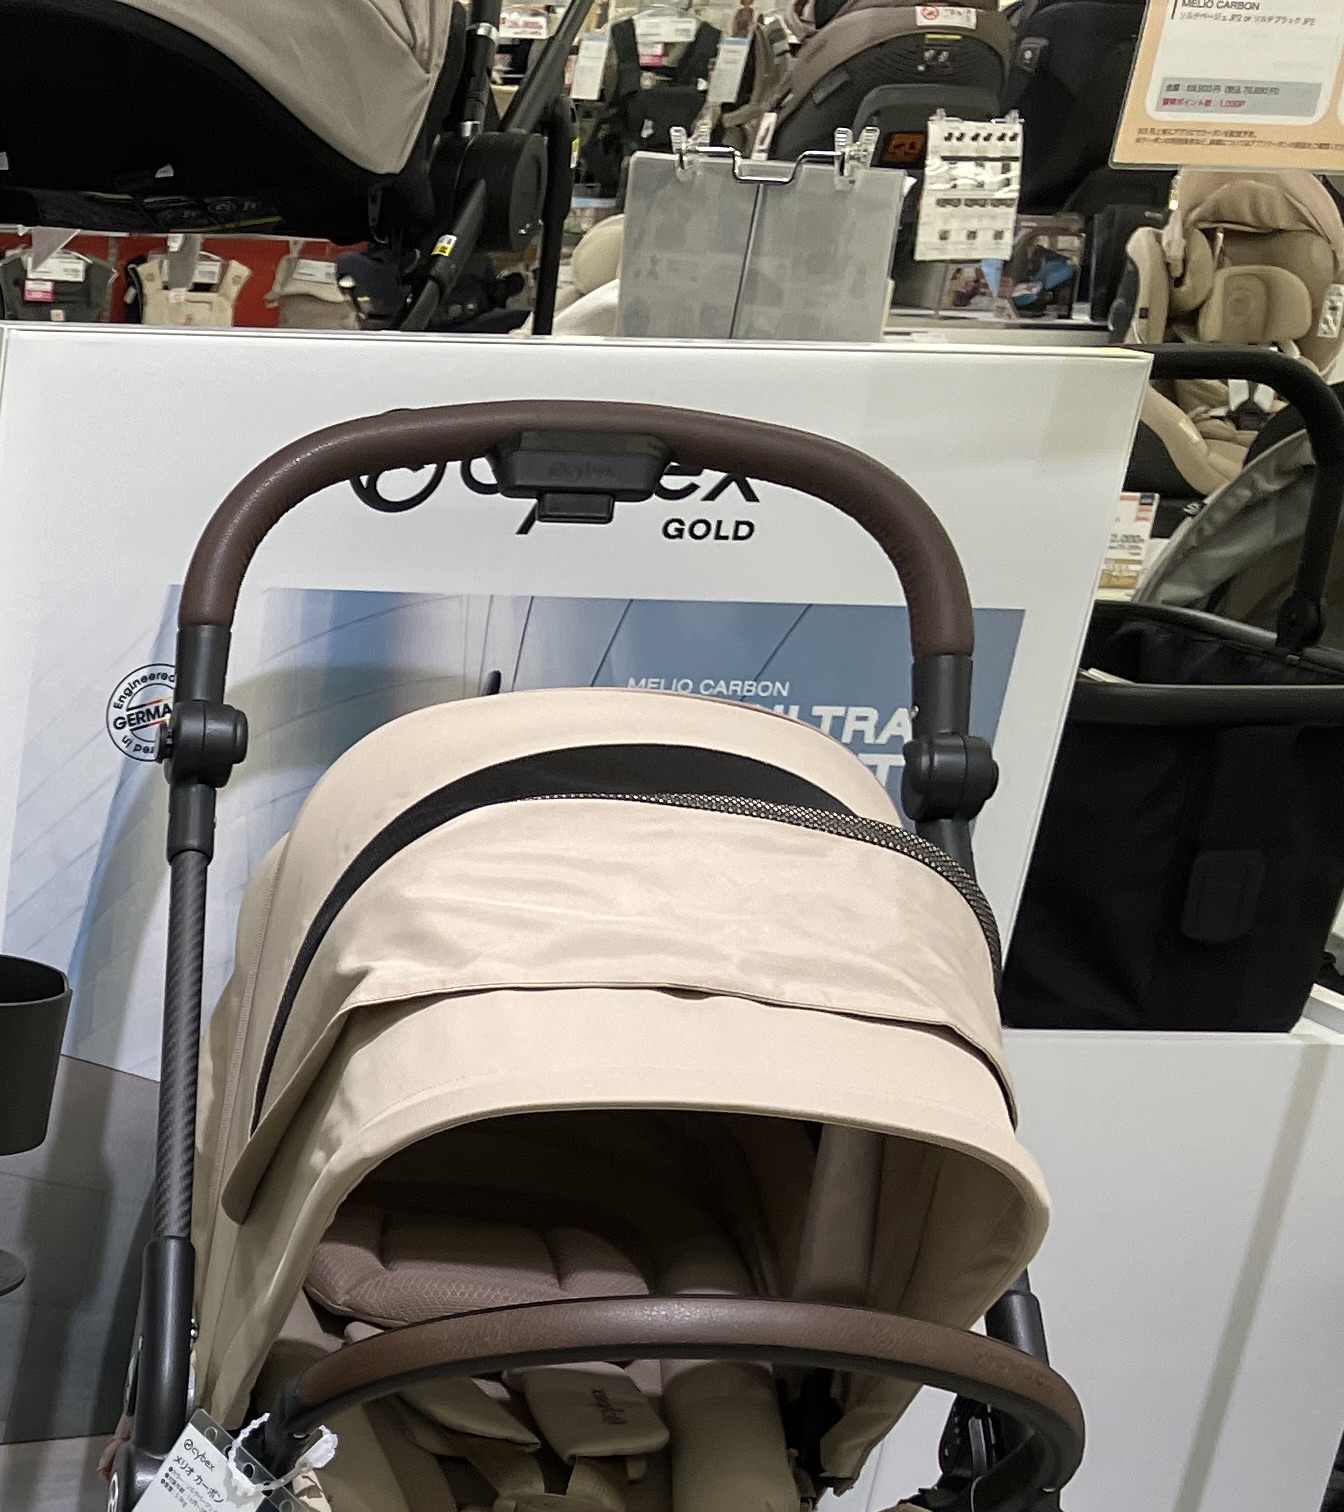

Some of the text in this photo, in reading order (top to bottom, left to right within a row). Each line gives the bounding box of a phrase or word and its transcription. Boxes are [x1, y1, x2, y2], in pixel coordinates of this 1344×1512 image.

[661, 518, 755, 542] GOLD
[699, 679, 791, 697] CARBON
[112, 703, 174, 731] GERMA
[191, 1447, 216, 1472] cybex
[172, 1455, 194, 1476] メリオ
[194, 1474, 225, 1503] カーボン
